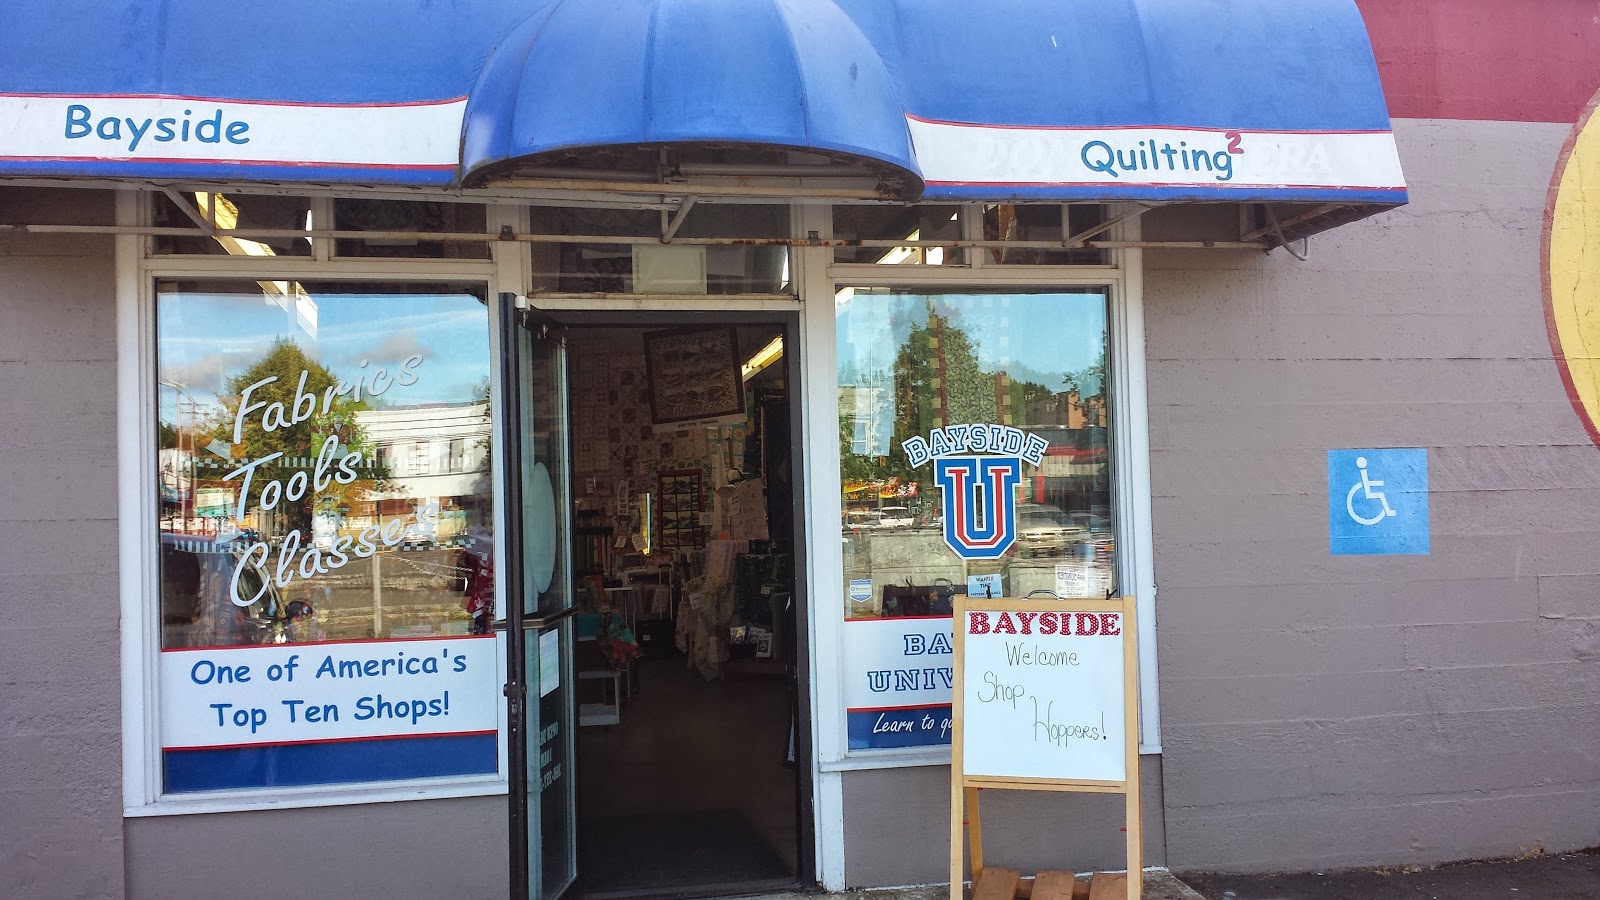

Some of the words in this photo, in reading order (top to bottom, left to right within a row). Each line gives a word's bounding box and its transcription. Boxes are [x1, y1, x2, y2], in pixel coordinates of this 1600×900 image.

[64, 104, 251, 152] Bayside
[233, 353, 424, 445] Fabrics
[903, 424, 1049, 468] BAYSIDE
[222, 434, 363, 524] Tools
[934, 456, 1023, 560] U
[229, 501, 438, 608] Classes
[903, 632, 954, 656] BA
[968, 612, 1121, 637] BAYSIDE
[190, 659, 252, 685] One
[266, 655, 299, 682] of
[315, 648, 468, 679] America's
[1005, 641, 1081, 667] Welcome
[867, 667, 953, 692] UNIV
[977, 670, 1025, 709] Shop
[209, 703, 267, 734] Top
[281, 699, 339, 723] Ten
[353, 690, 450, 725] Shops!
[872, 712, 915, 734] Learn
[921, 713, 935, 730] to
